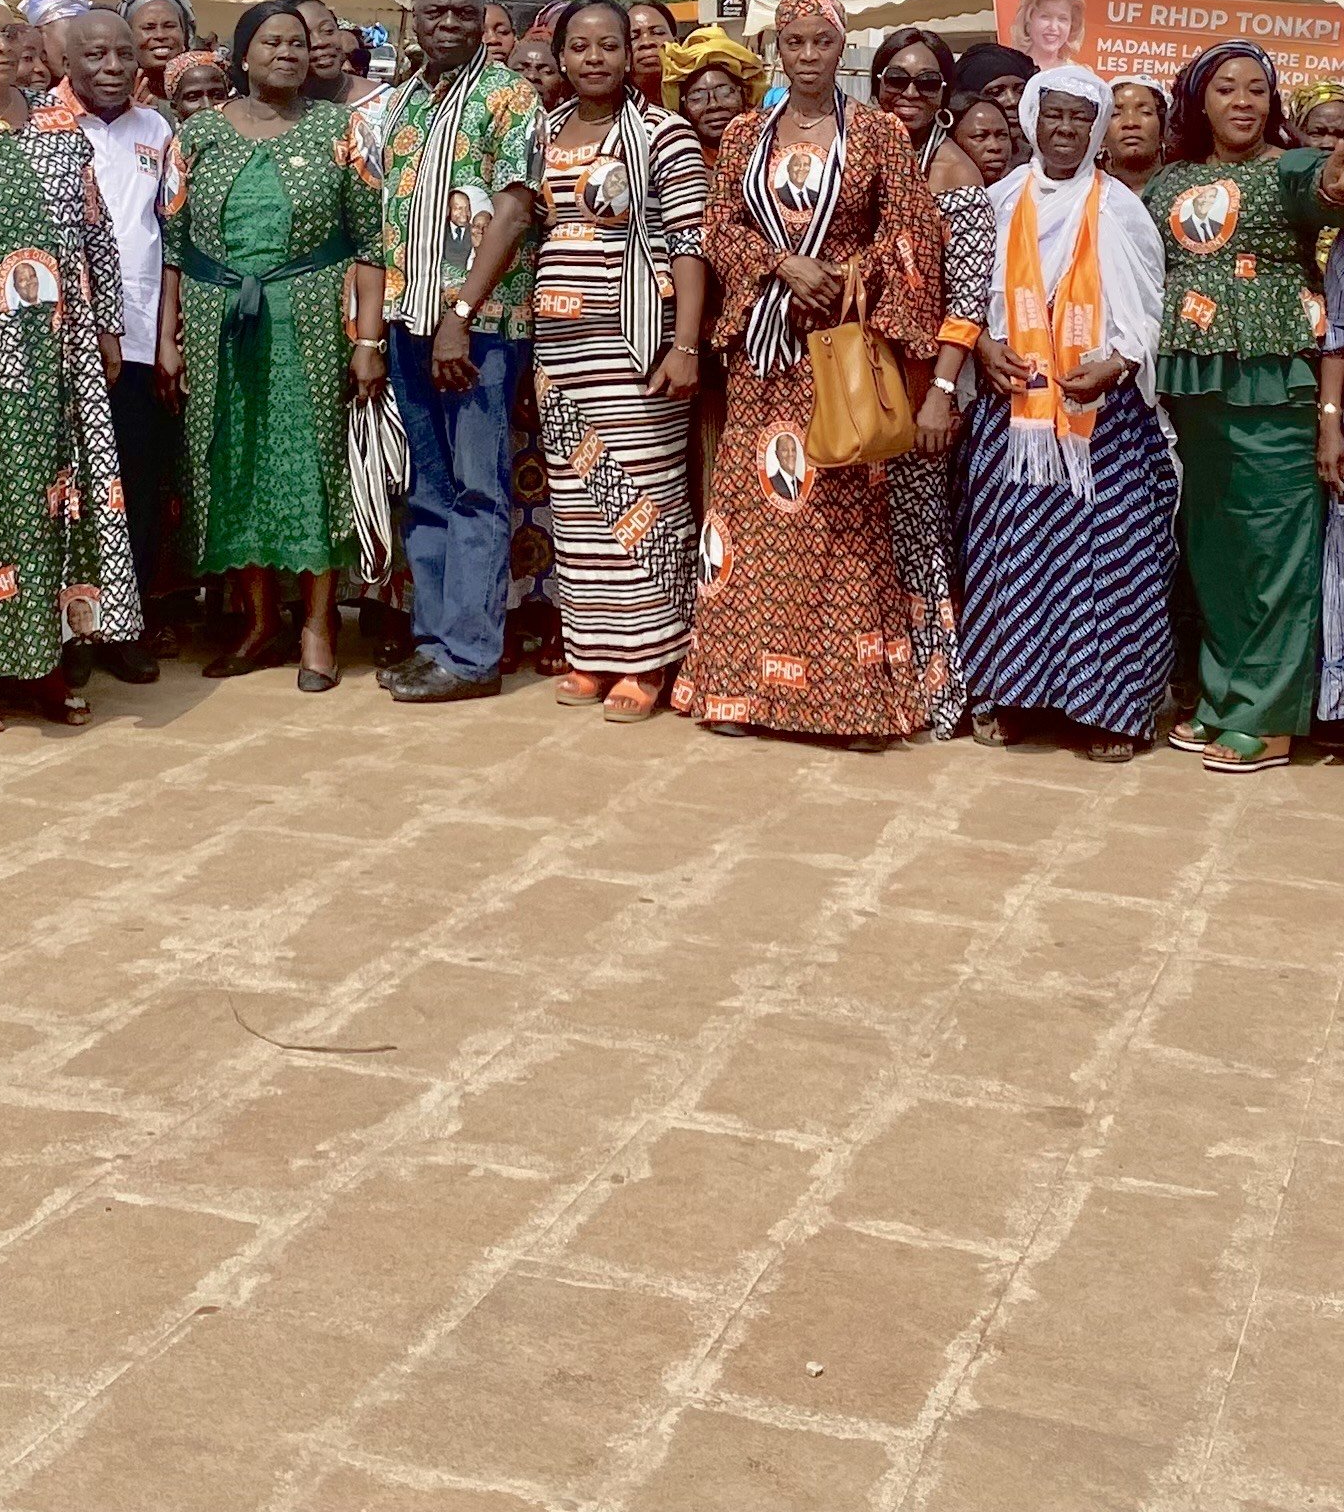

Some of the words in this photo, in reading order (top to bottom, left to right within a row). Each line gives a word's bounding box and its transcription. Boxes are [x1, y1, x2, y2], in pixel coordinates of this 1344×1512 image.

[1107, 1, 1143, 24] UF
[1149, 5, 1230, 31] RHDP
[1236, 10, 1341, 41] TONKPI
[1096, 38, 1177, 58] MADAME
[1097, 57, 1128, 72] LES
[1133, 60, 1186, 75] FEMM
[33, 110, 74, 128] RHD
[539, 294, 581, 315] RHDP
[573, 434, 598, 471] RHDP
[616, 500, 655, 544] RHDP
[706, 701, 747, 720] HDP
